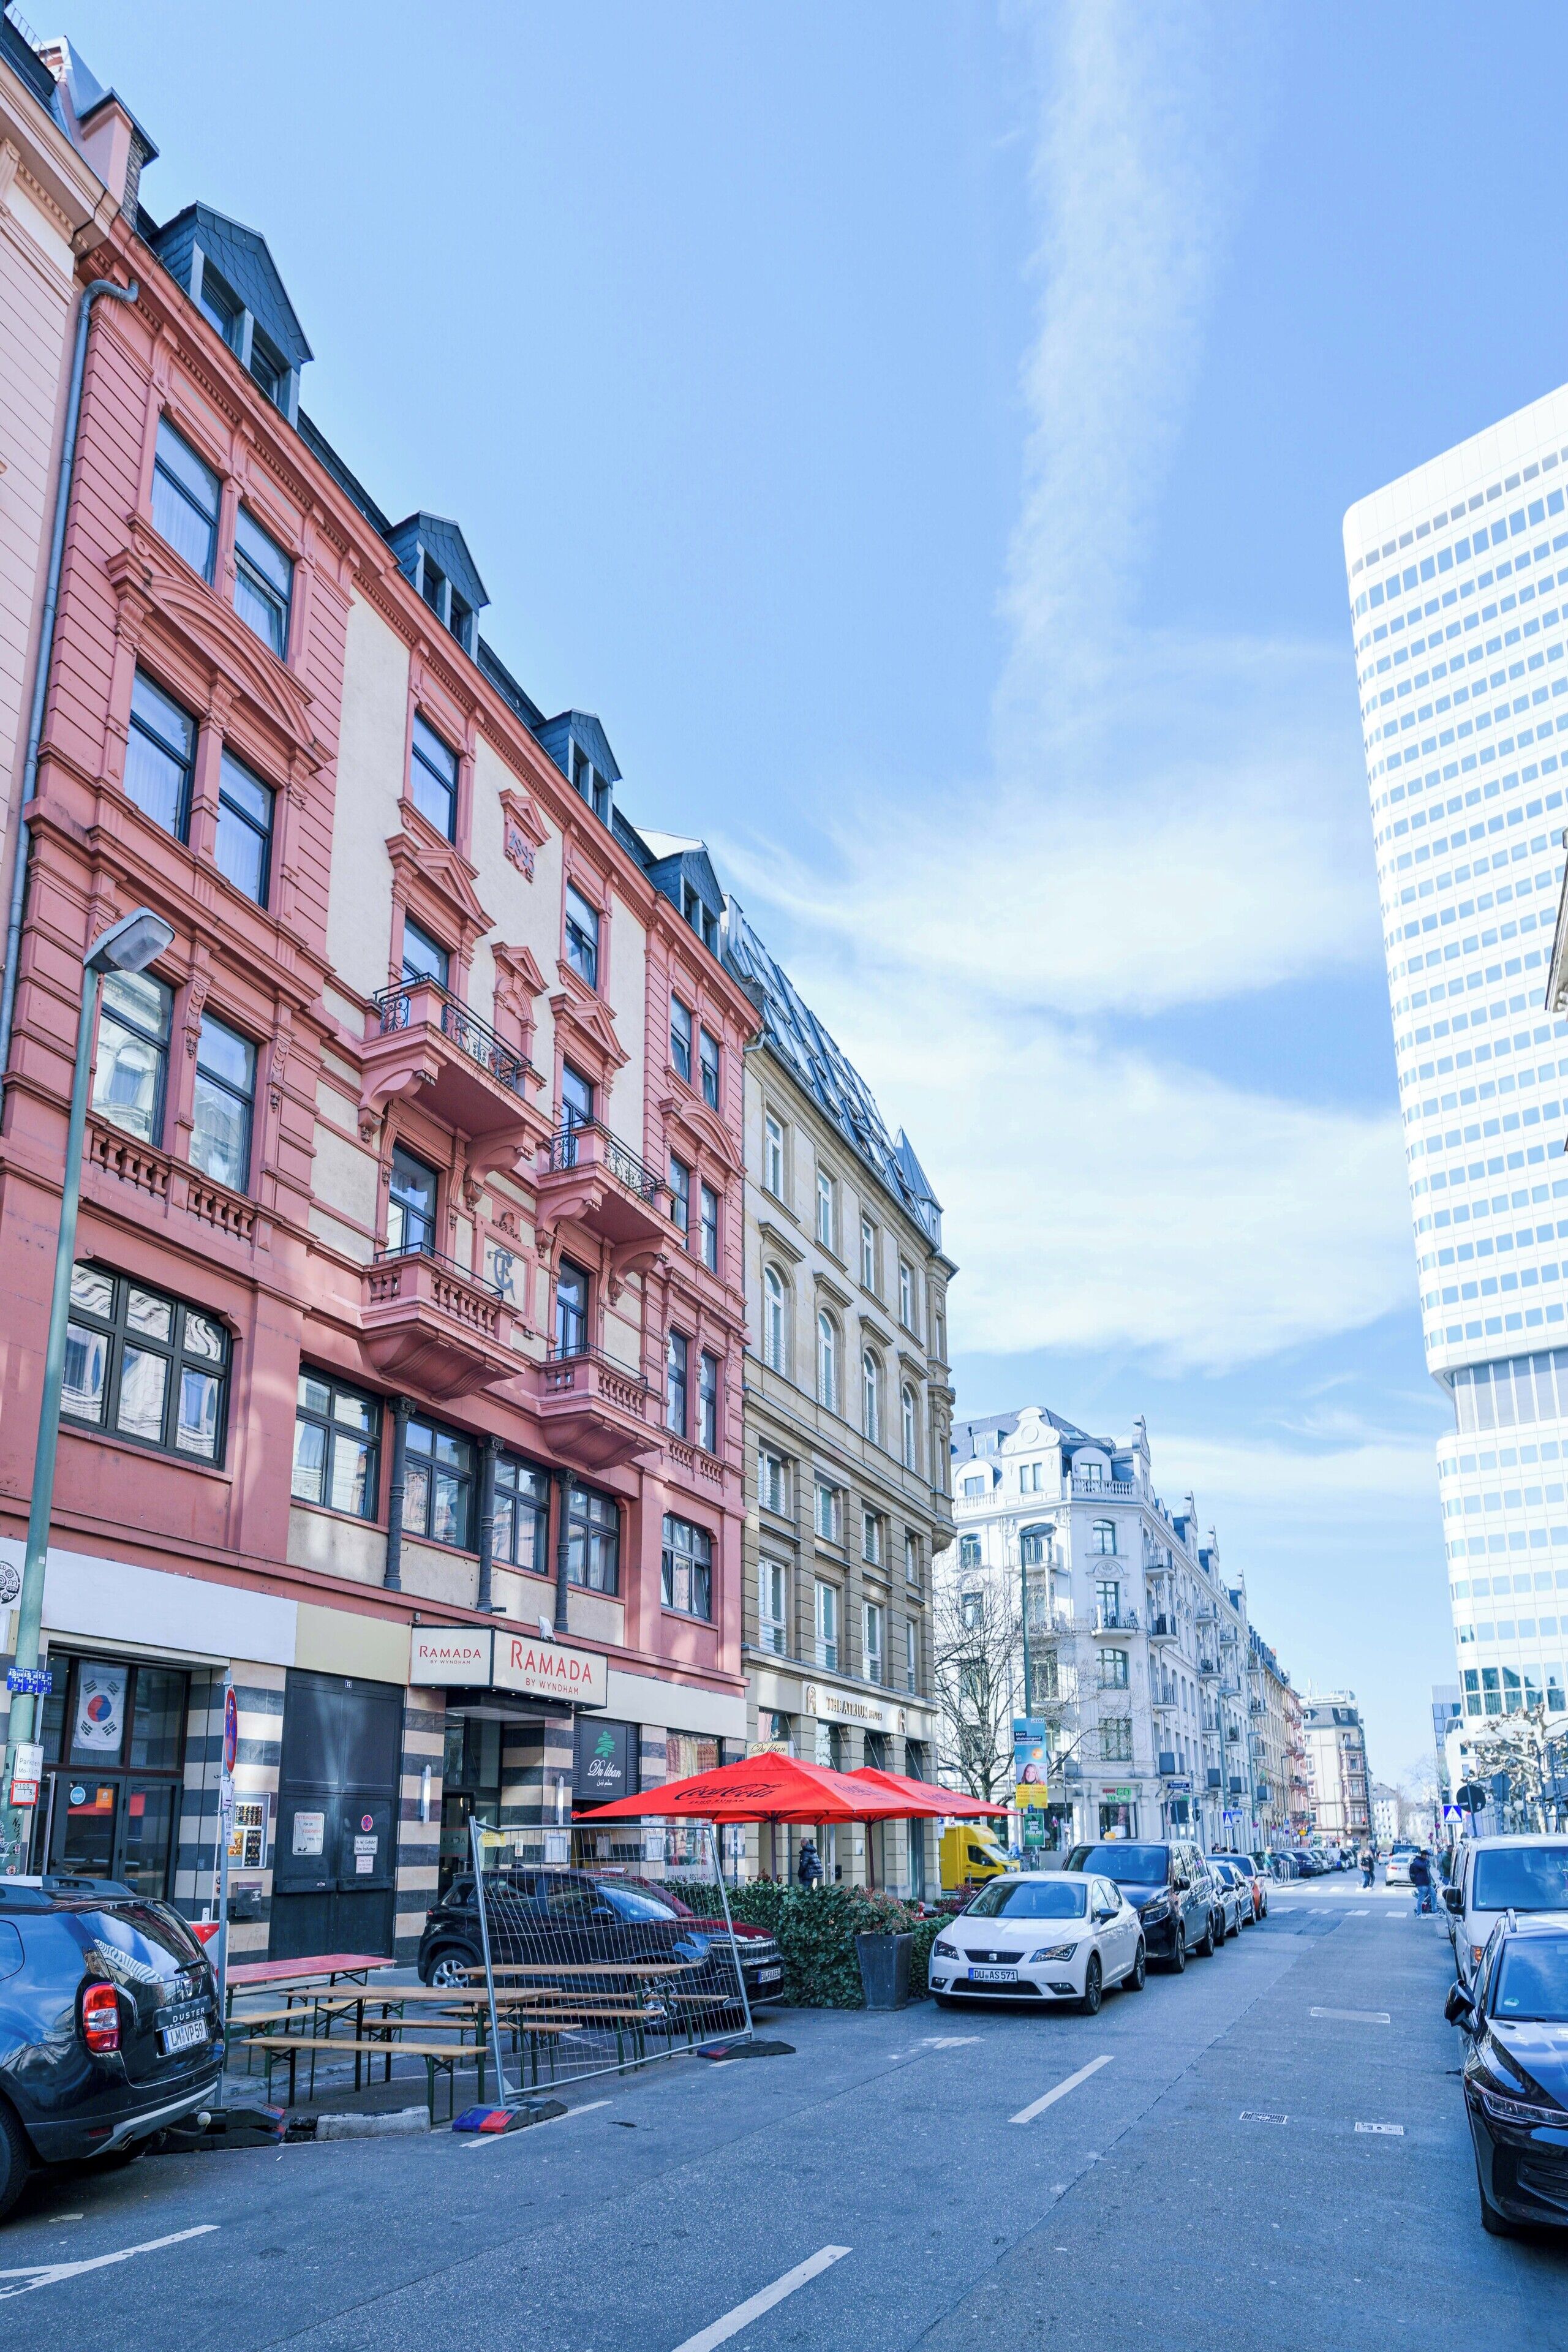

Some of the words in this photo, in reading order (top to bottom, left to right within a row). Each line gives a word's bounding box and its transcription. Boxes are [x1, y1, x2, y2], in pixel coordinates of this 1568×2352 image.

[420, 1645, 481, 1659] RAMADA
[511, 1640, 592, 1684] RAMADA
[526, 1678, 536, 1686] BY
[539, 1680, 579, 1695] WYNDHAM
[826, 1696, 842, 1713] THE
[842, 1700, 868, 1719] ATRIUM
[749, 1742, 767, 1754] Du
[587, 1759, 606, 1776] Du
[604, 1762, 622, 1779] liban
[974, 1970, 984, 1979] DU
[989, 1970, 1000, 1980] AS
[1001, 1971, 1016, 1980] 571
[173, 2007, 205, 2022] DUSTER
[170, 2029, 183, 2047] LM
[184, 2025, 194, 2041] VP
[195, 2022, 203, 2038] 59
